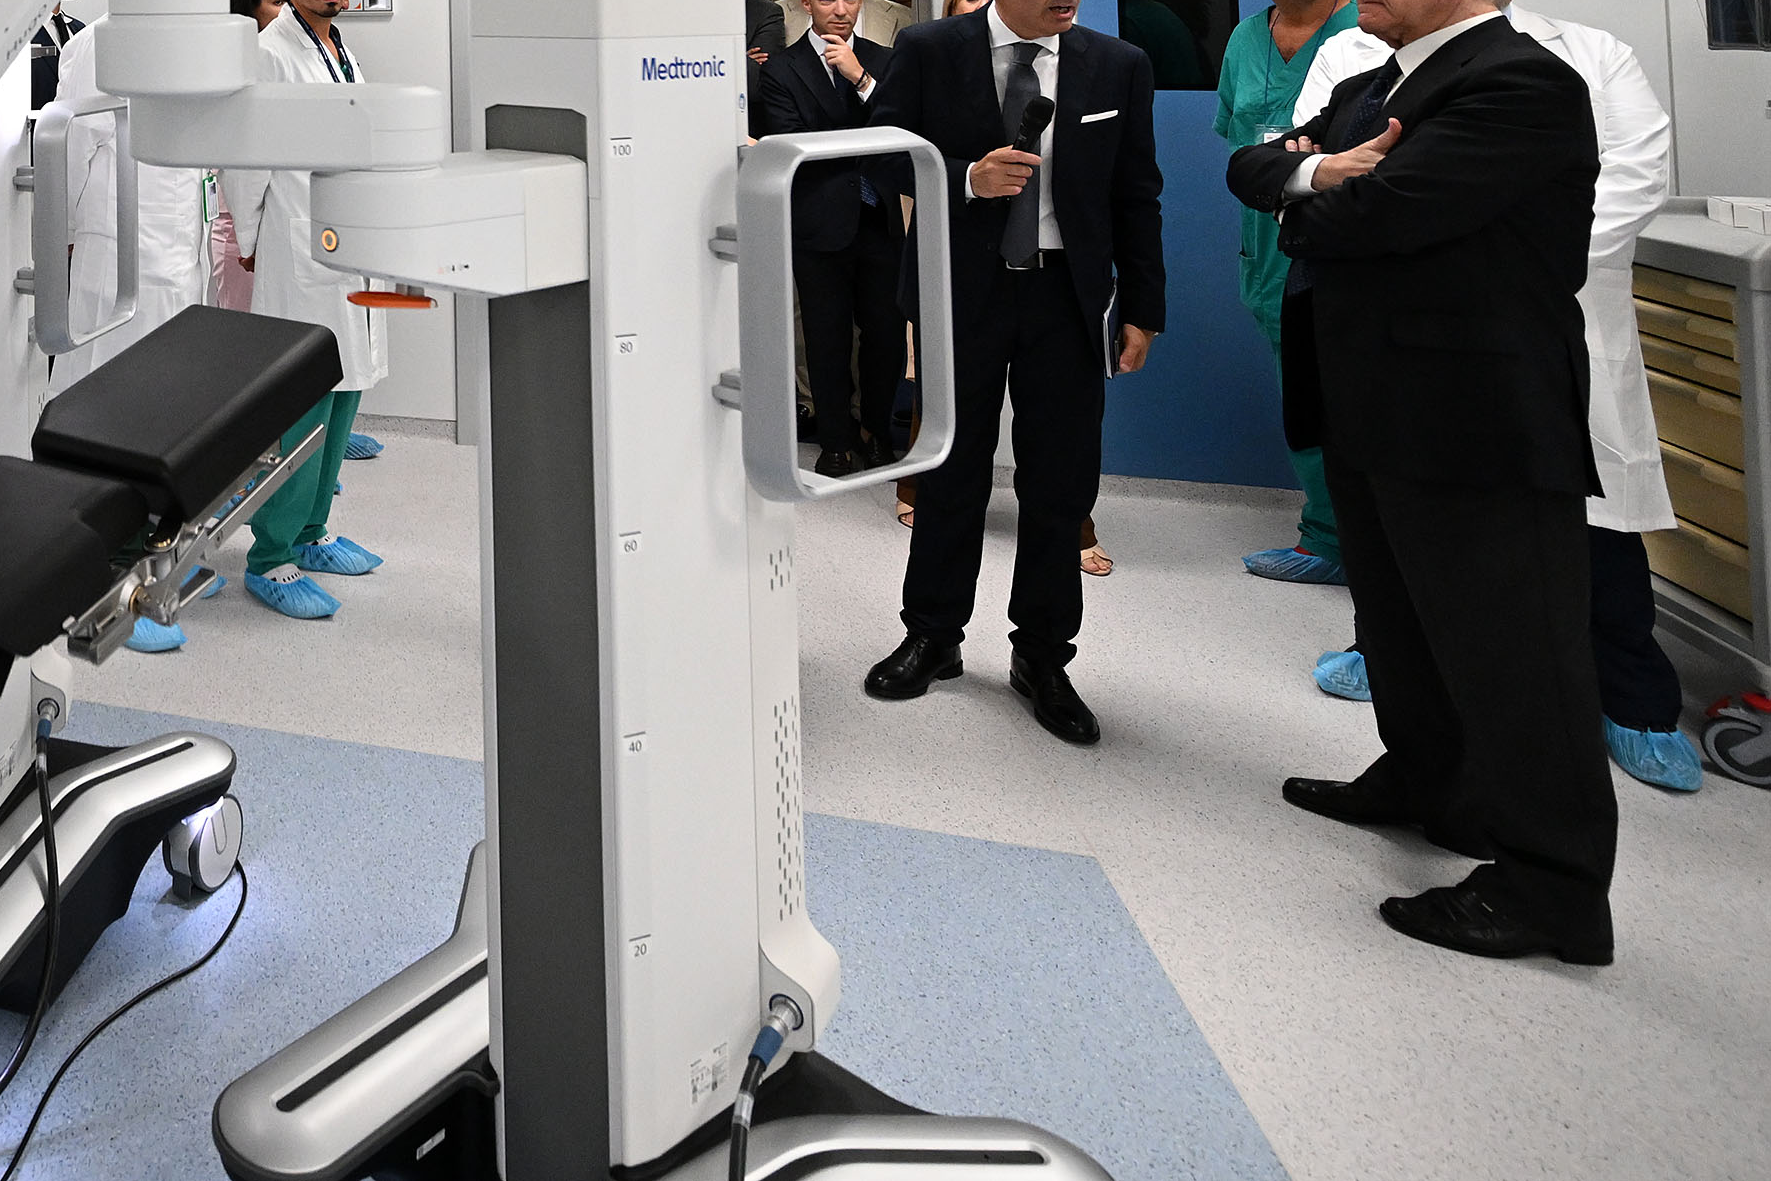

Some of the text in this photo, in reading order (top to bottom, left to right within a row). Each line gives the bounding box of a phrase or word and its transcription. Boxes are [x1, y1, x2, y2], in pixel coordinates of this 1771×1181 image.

[642, 55, 726, 81] Medtronic
[612, 144, 632, 156] 100
[619, 341, 633, 354] 80
[624, 539, 638, 553] 60
[628, 740, 643, 753] 40
[634, 943, 648, 958] 20
